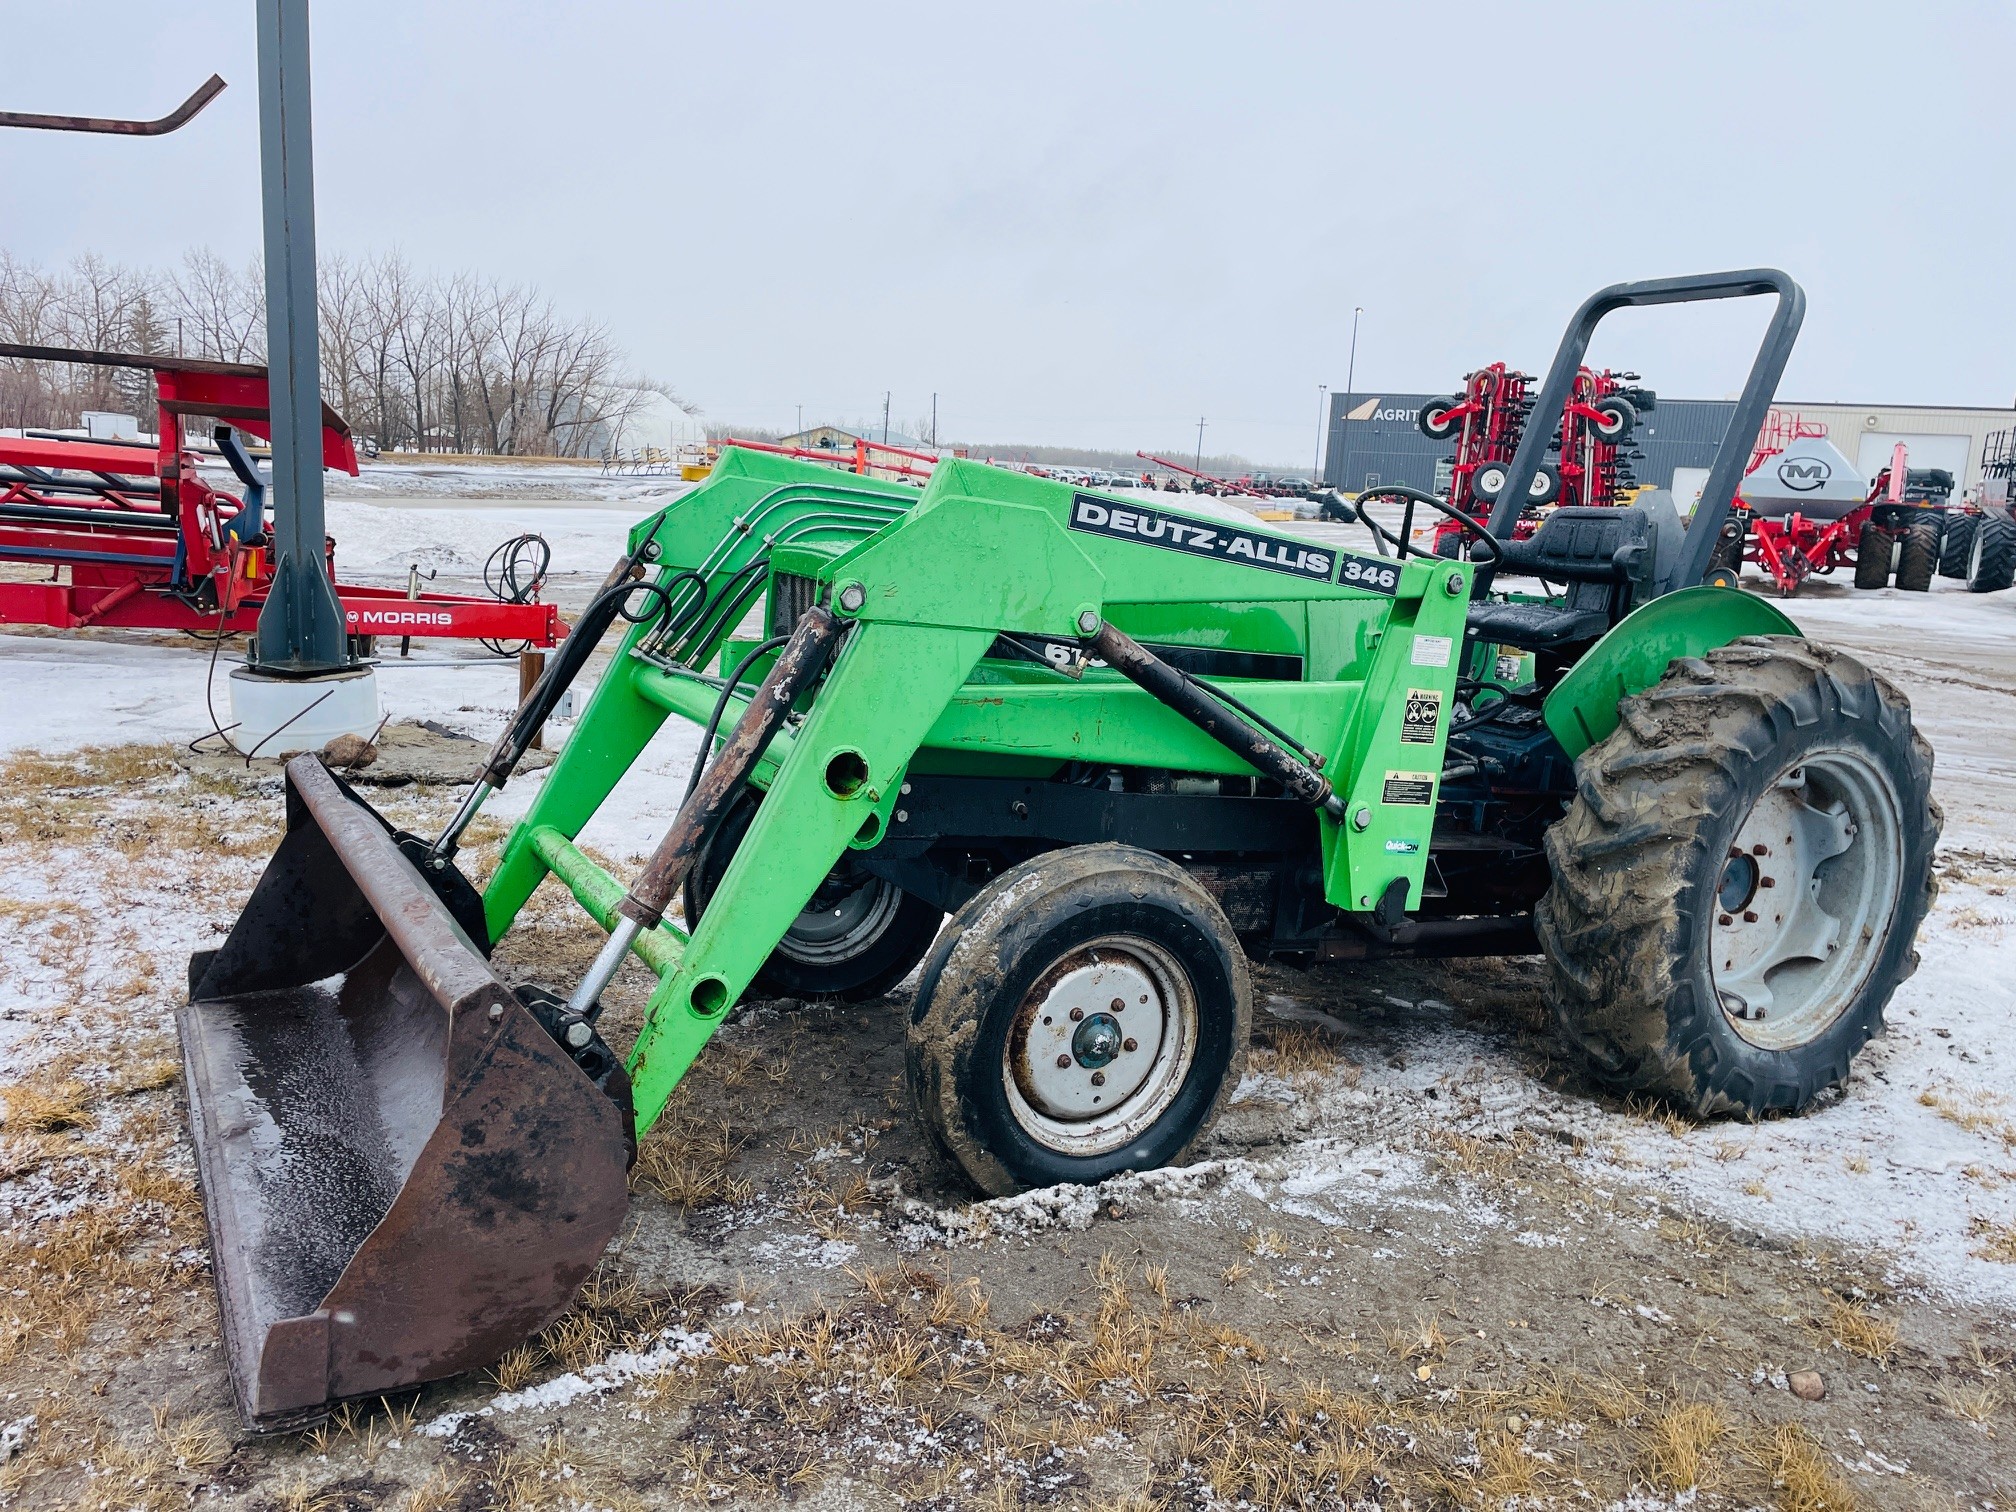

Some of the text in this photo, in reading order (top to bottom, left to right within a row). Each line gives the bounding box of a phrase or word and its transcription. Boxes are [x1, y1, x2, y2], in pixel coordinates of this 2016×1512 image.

[1076, 502, 1396, 588] DEUTZ-ALLIS 346
[363, 611, 452, 625] MORRIS
